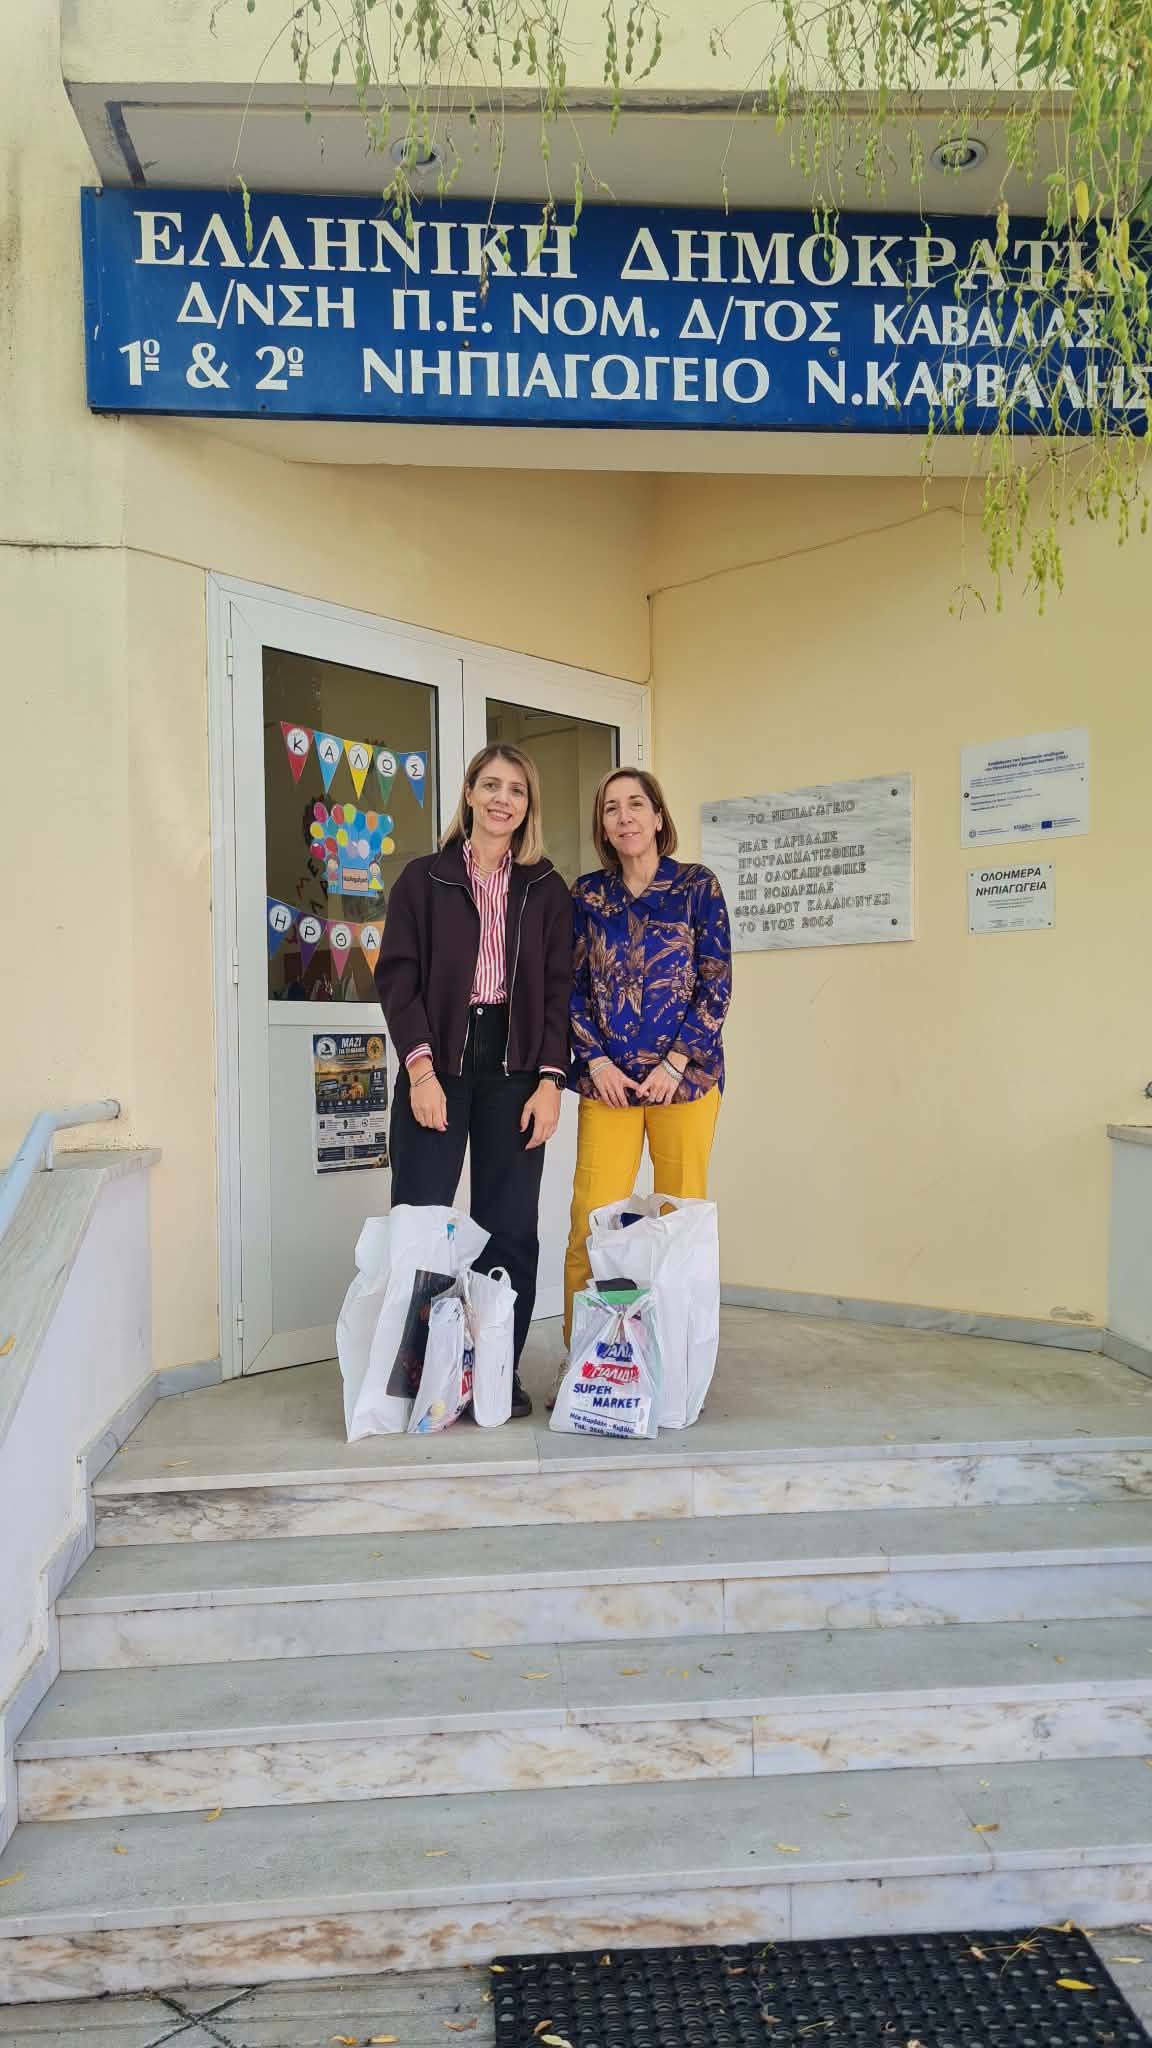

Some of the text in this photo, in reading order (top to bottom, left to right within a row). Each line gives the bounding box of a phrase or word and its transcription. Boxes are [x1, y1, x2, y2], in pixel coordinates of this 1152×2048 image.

[133, 210, 578, 280] ΕΛΛΗΝΙΚΗ
[176, 279, 1107, 349] Δ/ΝΣΗ Π.Ε. ΝΟΜ. Δ/ΤΟΣ ΚΑΒΑΛΑΣ
[185, 342, 231, 390] &
[362, 347, 770, 404] ΝΗΠΙΑΓΩΓΕΙΟ
[747, 812, 766, 825] ΤΟ
[738, 839, 769, 854] ΝΕΑΣ
[738, 872, 758, 886] ΚΑΙ
[980, 867, 1041, 882] ΟΛΟΗΜΕΡΑ
[738, 881, 834, 901] ΕΠΙ ΝΟΜΑΡΧΙΑΣ
[975, 881, 1047, 897] ΝΗΠΙΑΓΩΓΕΙΑ
[738, 921, 756, 933] ΤΟ
[762, 918, 795, 932] ΕΤΟΣ
[573, 1383, 612, 1395] SUPER
[592, 1397, 641, 1409] MARKET
